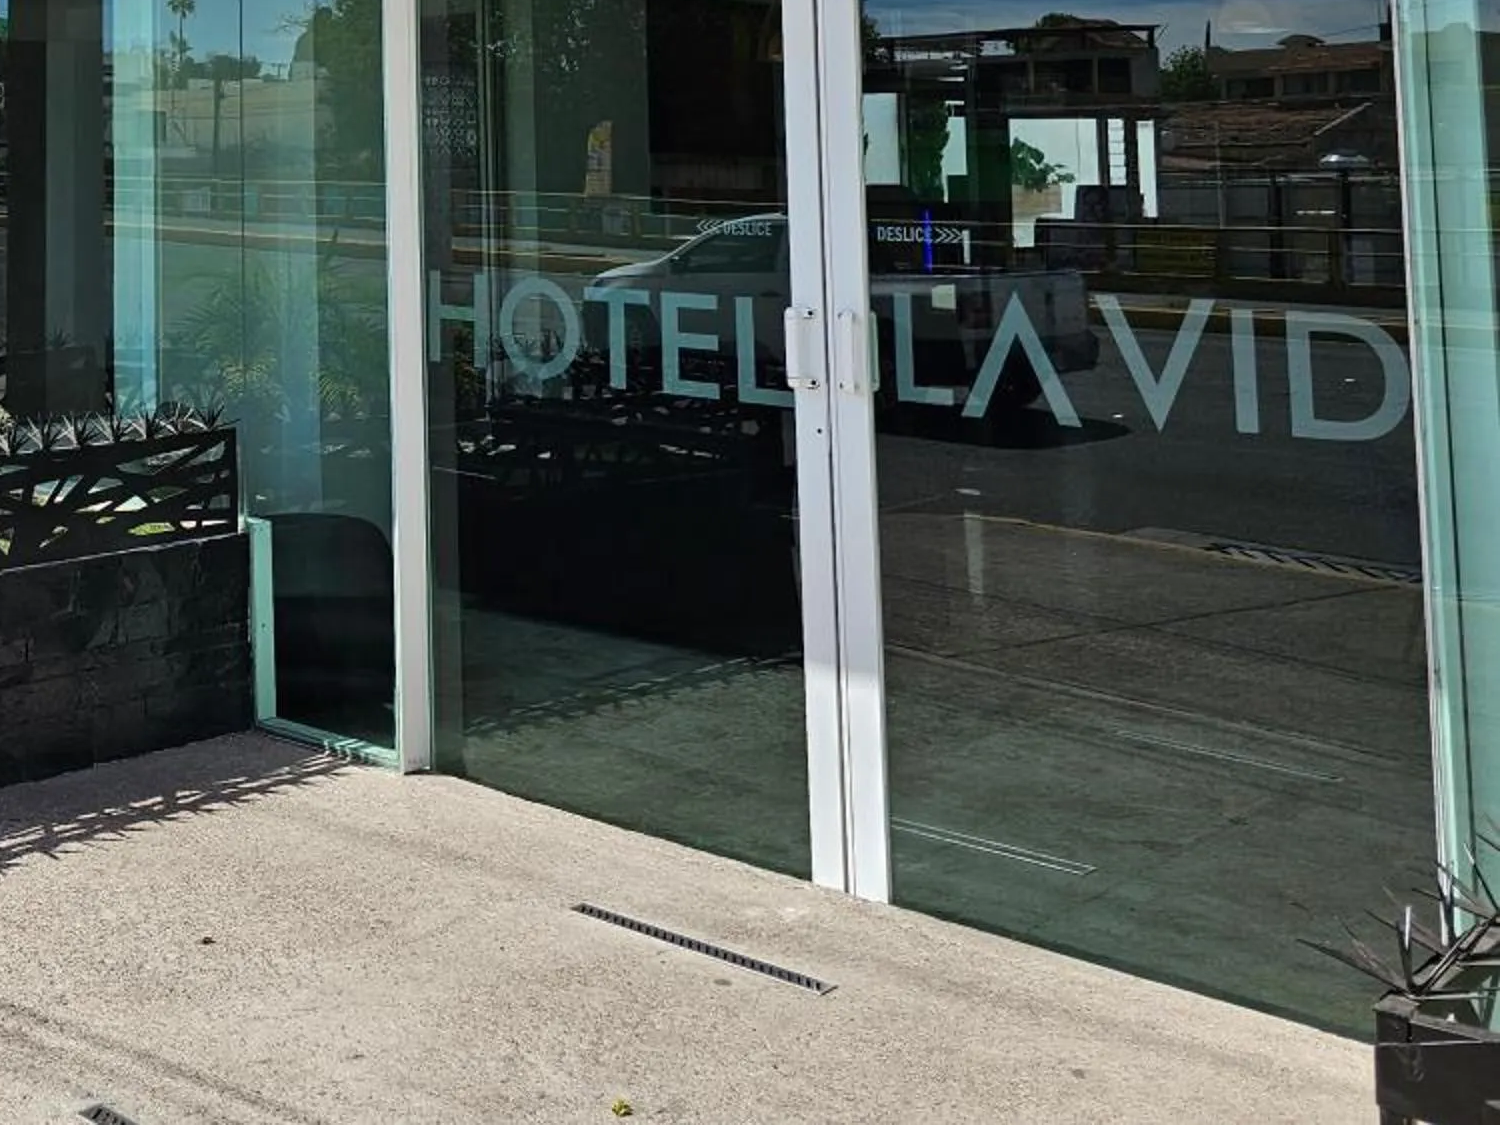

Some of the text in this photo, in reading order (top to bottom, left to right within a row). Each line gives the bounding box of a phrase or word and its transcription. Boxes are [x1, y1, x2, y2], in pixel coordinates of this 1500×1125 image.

[723, 222, 773, 236] DESLICE
[877, 226, 932, 243] DESLICE
[429, 270, 795, 409] HOTEL
